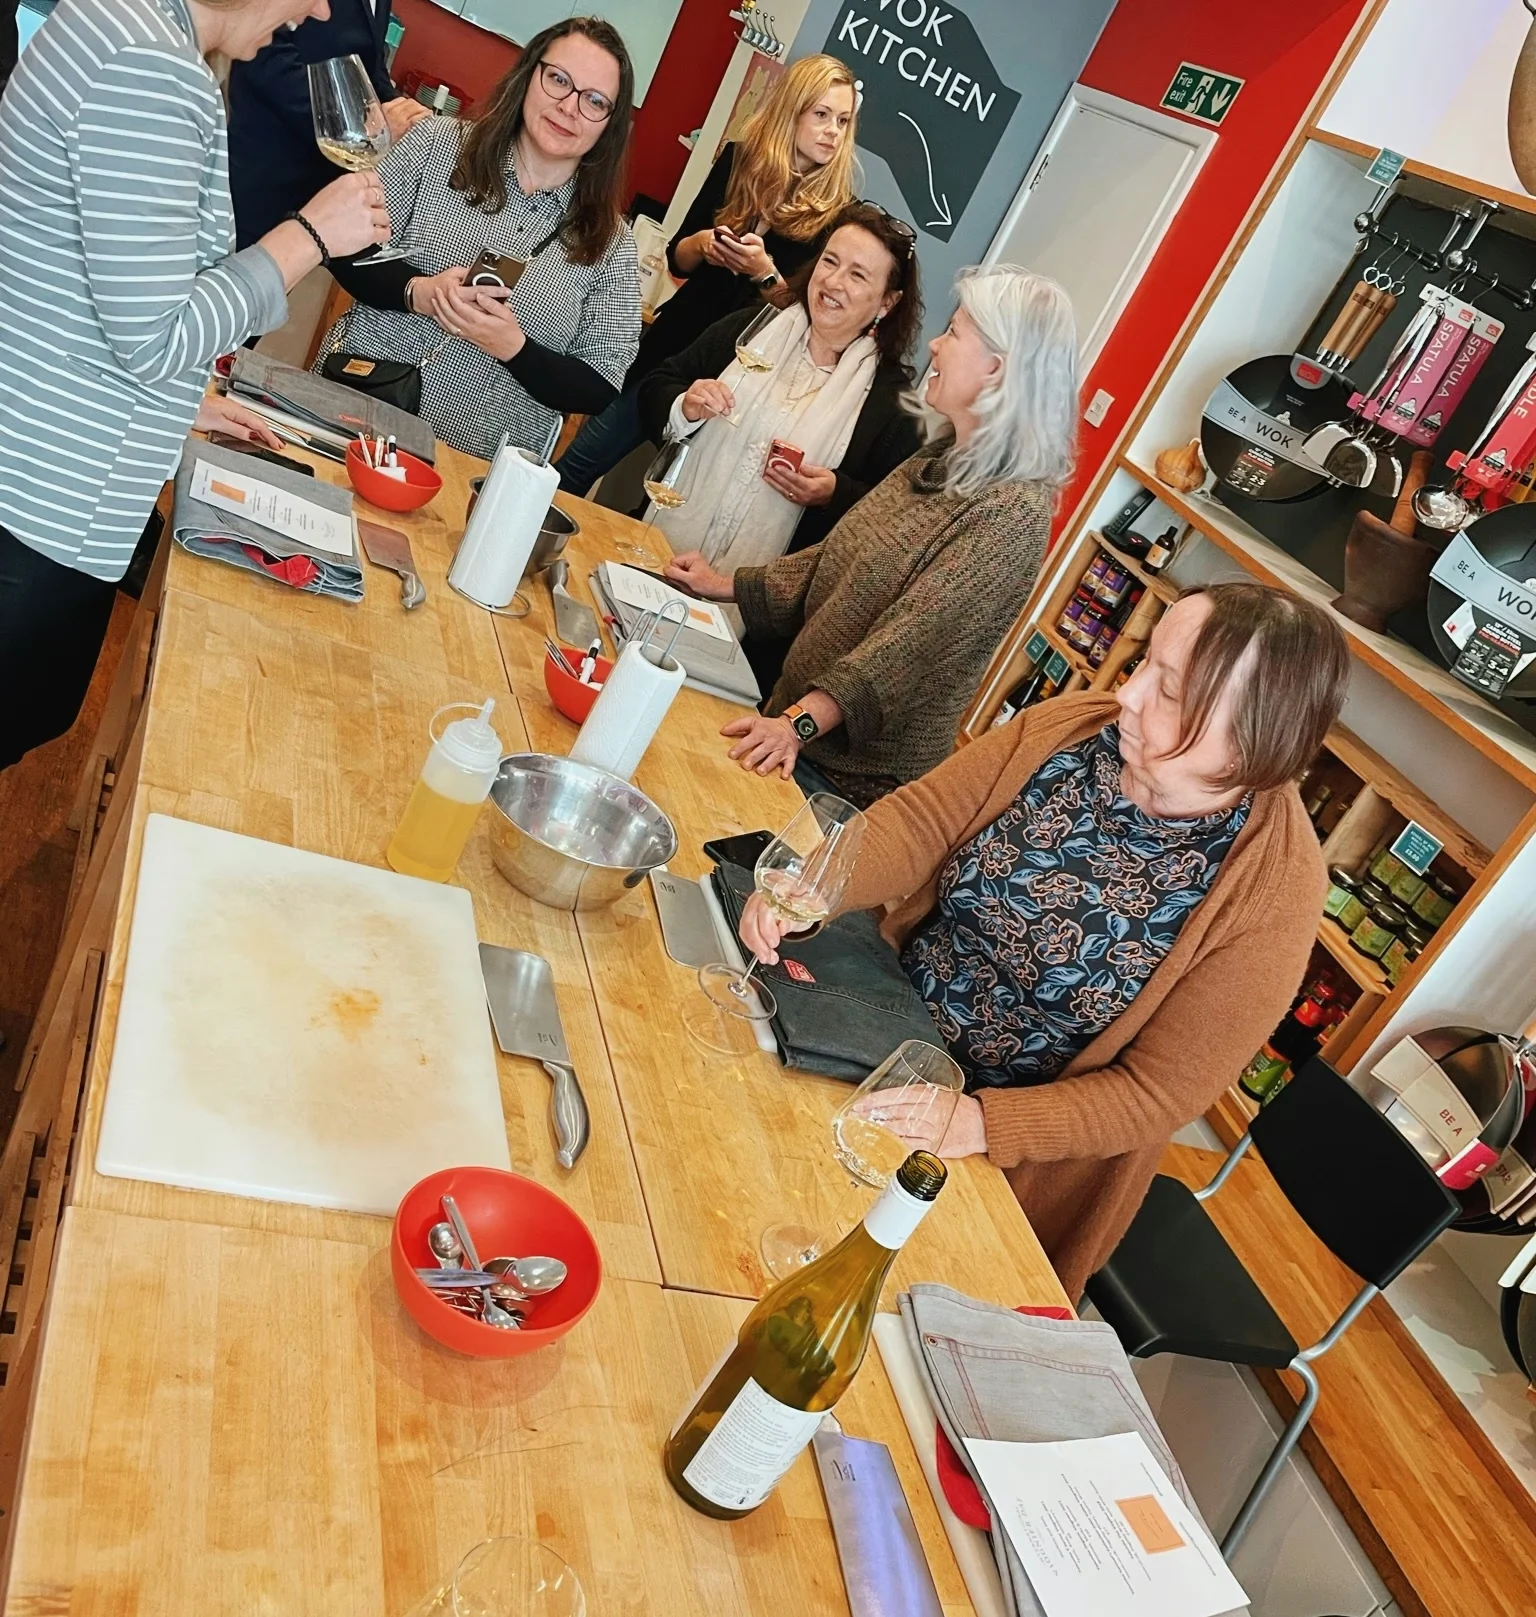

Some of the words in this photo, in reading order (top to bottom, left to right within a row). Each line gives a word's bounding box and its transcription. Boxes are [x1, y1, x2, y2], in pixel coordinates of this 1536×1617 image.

[838, 9, 997, 122] KITCHEN
[1176, 72, 1194, 88] Fire
[1169, 89, 1187, 103] exit
[1410, 322, 1454, 385] SPATULA
[1437, 336, 1481, 398] SPATULA
[1228, 407, 1240, 418] BE
[1240, 414, 1247, 424] A
[1256, 421, 1294, 449] WOK
[1457, 560, 1468, 574] BE
[1468, 571, 1476, 581] A
[1487, 659, 1509, 676] 3-4
[1439, 1108, 1456, 1126] BE
[1452, 1127, 1463, 1137] A
